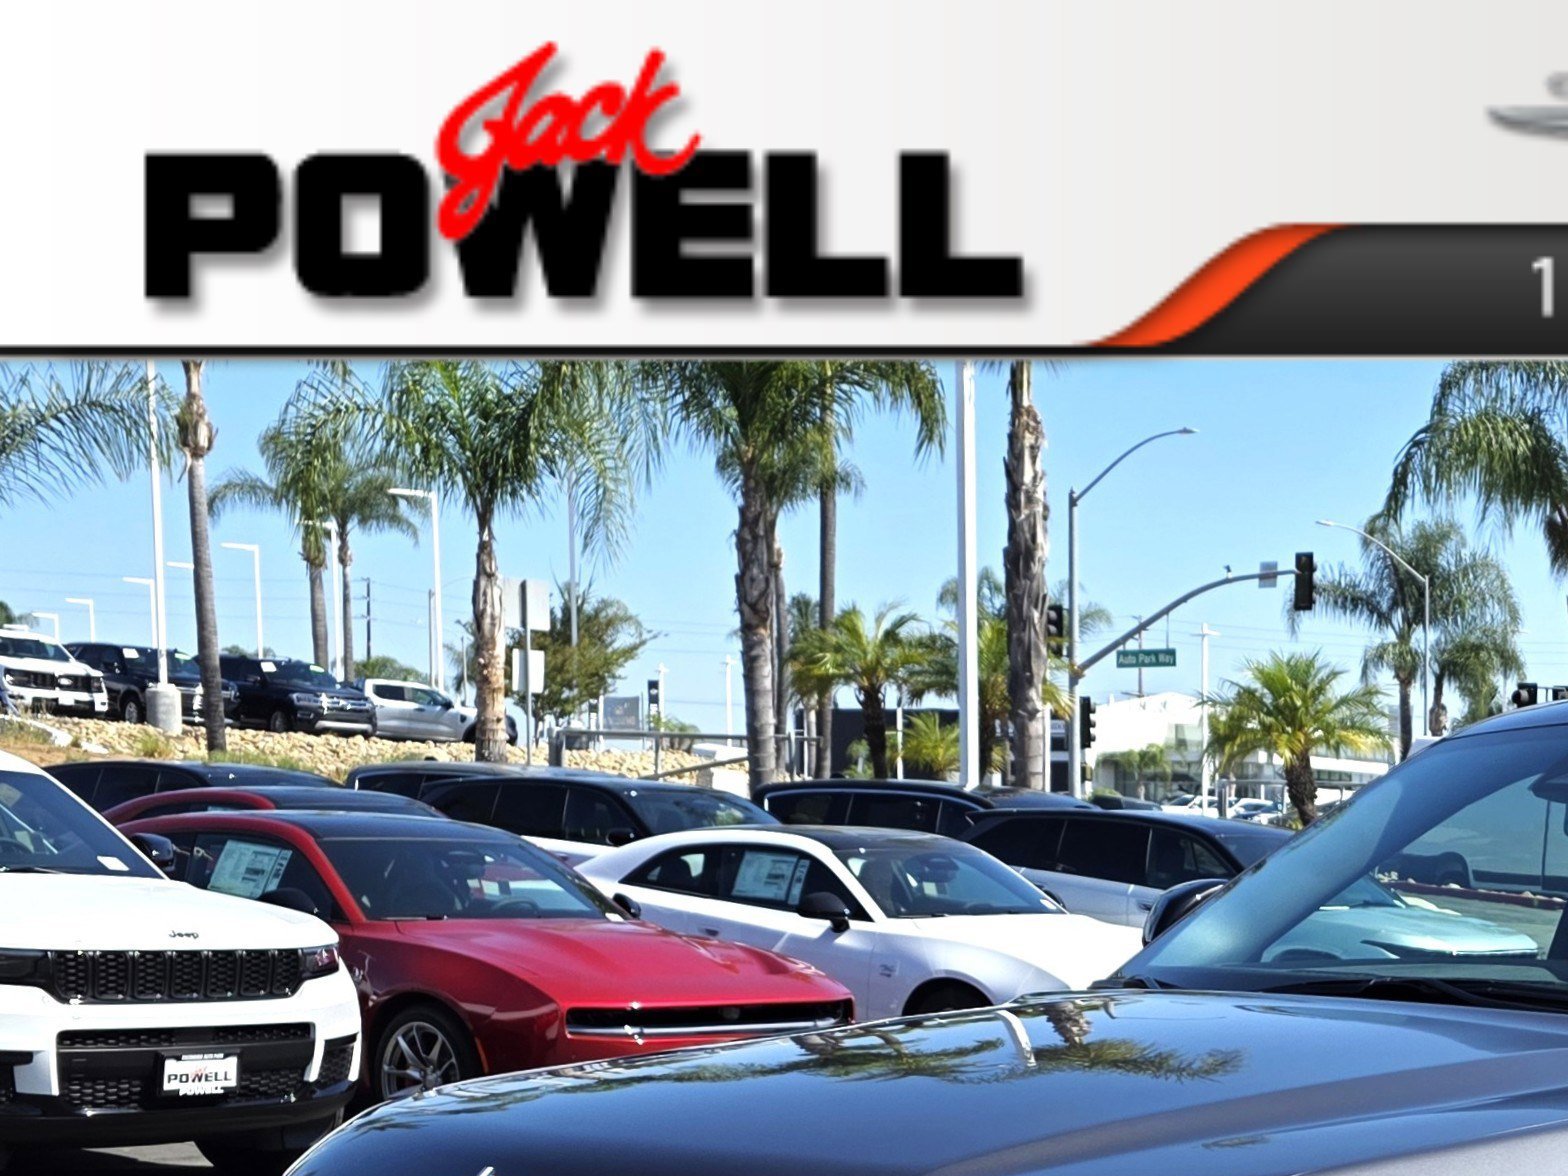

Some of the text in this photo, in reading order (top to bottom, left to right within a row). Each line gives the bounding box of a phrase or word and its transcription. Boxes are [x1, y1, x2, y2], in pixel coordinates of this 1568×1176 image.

[1138, 653, 1157, 664] Park
[168, 929, 199, 940] Jeep
[166, 1070, 233, 1084] POWELL
